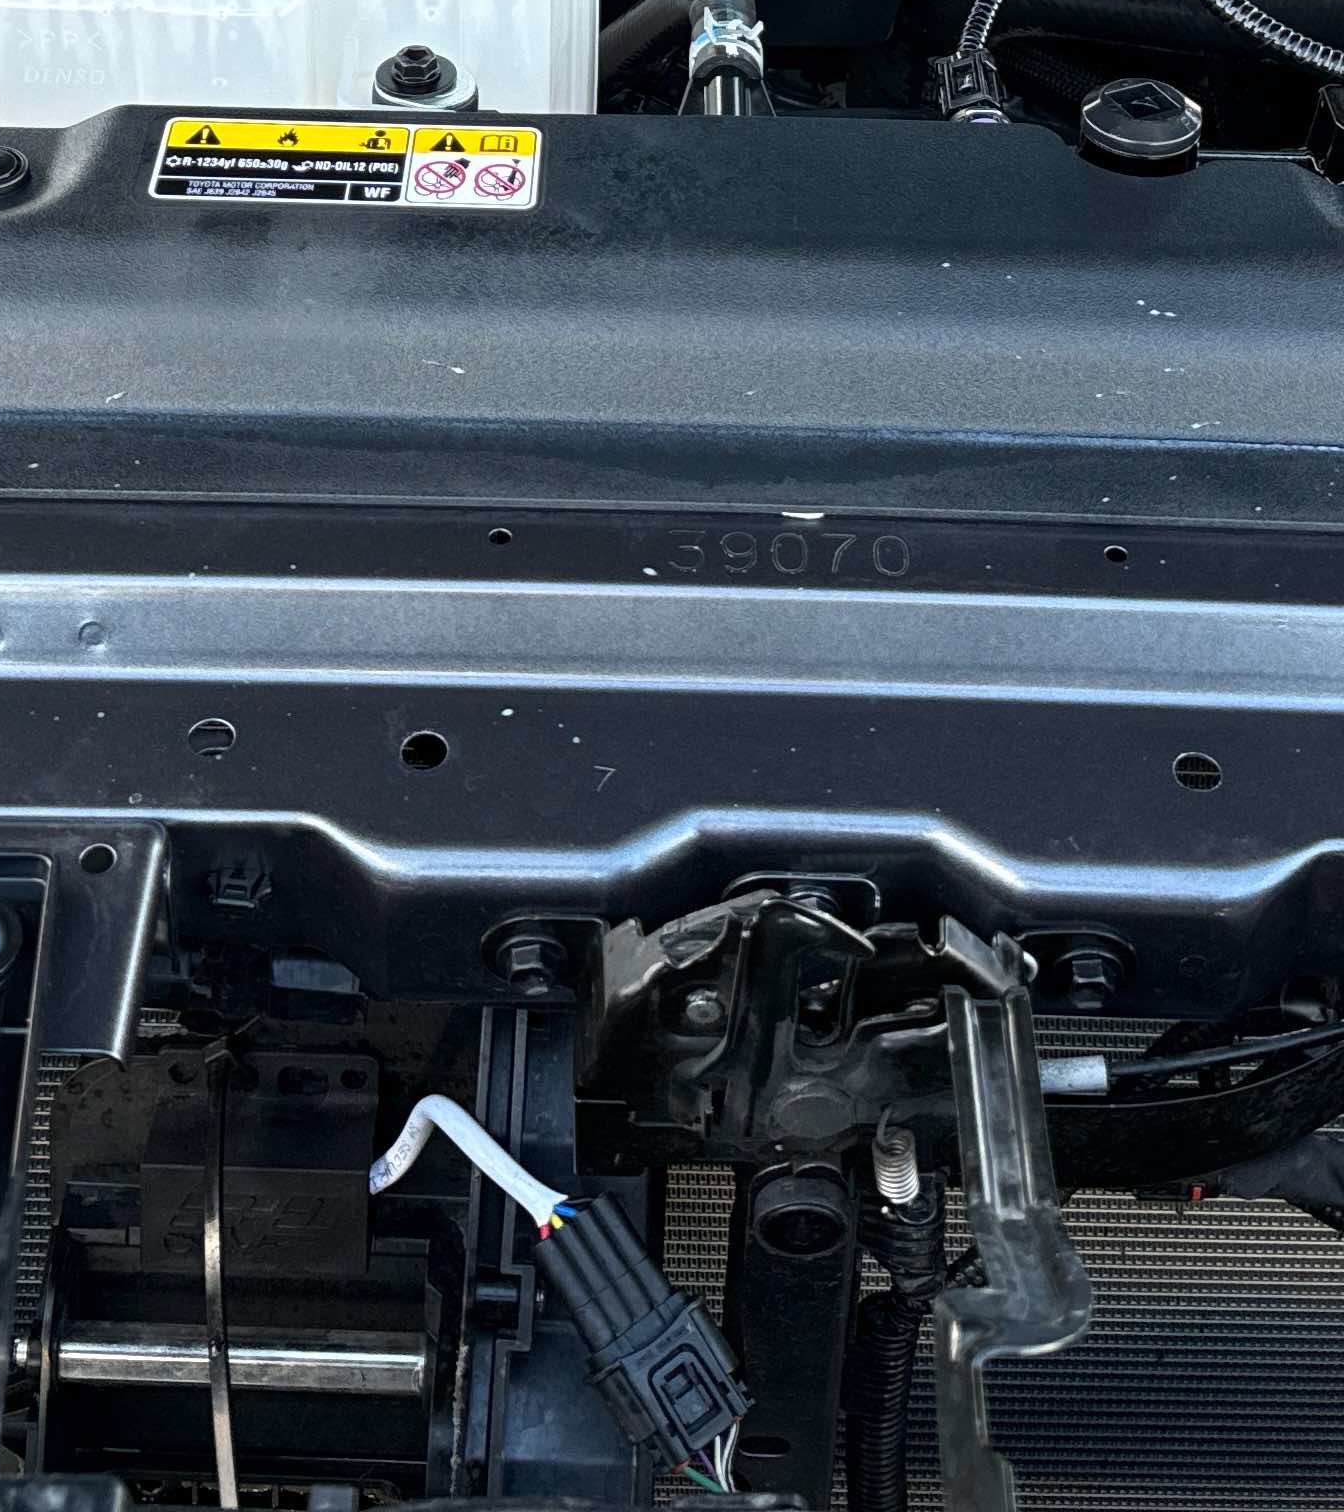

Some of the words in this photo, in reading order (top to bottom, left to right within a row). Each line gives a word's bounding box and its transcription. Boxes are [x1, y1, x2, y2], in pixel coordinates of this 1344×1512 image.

[23, 65, 106, 85] DENSO
[182, 155, 236, 169] R-1234yf
[188, 180, 221, 188] TOYOTA
[223, 181, 253, 189] MOTOR
[364, 186, 391, 198] WF
